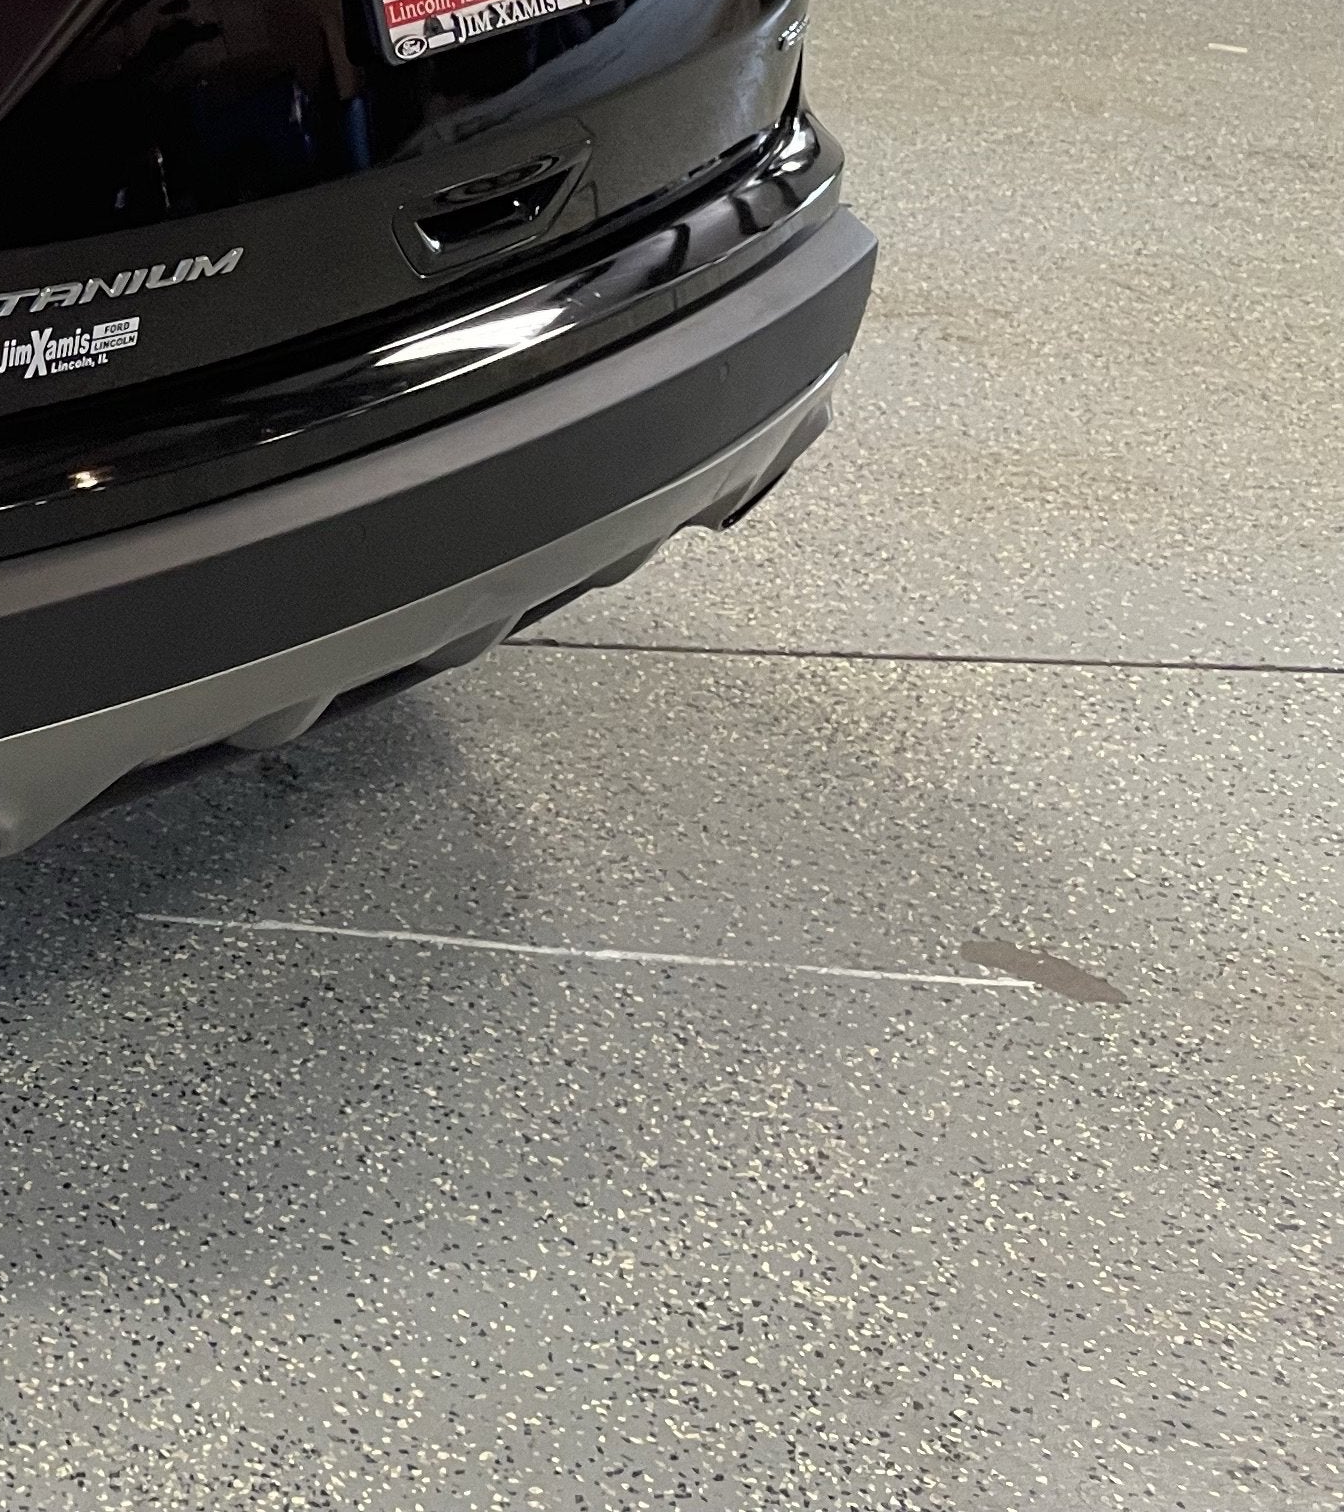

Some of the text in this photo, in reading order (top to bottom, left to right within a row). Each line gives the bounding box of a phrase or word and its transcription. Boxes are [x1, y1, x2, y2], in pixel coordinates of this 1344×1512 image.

[456, 12, 493, 43] JIM
[104, 321, 131, 335] FORD
[93, 334, 136, 351] LINCOLN
[50, 352, 109, 374] Lincoln, IL
